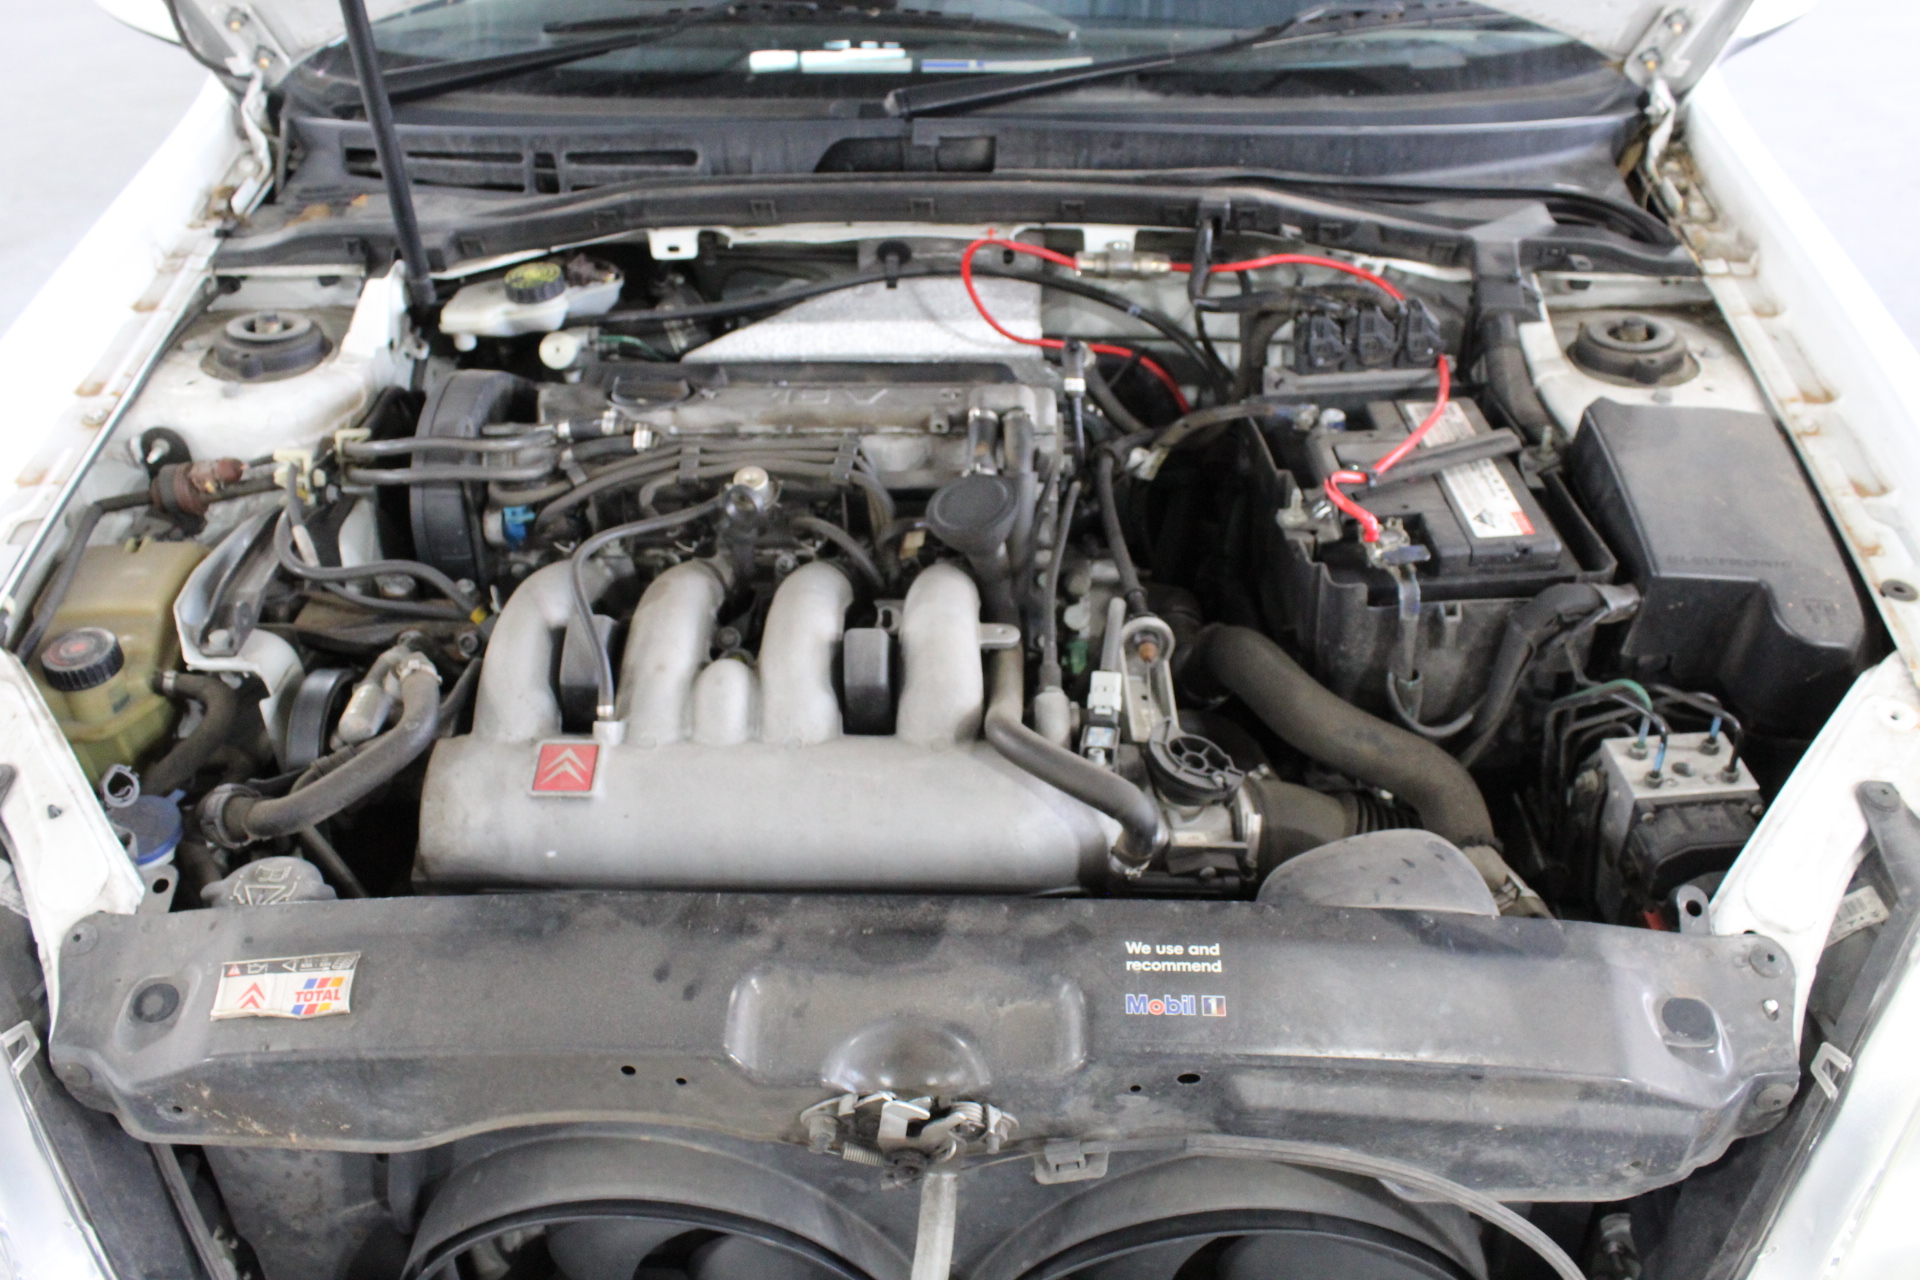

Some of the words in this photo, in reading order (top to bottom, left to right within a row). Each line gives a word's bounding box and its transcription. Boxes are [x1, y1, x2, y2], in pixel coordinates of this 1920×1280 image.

[1125, 941, 1151, 955] We
[1155, 944, 1184, 955] use
[1188, 943, 1220, 956] and
[1125, 960, 1222, 972] recommend
[295, 989, 341, 1003] TOTAL
[1125, 994, 1197, 1016] Mobil
